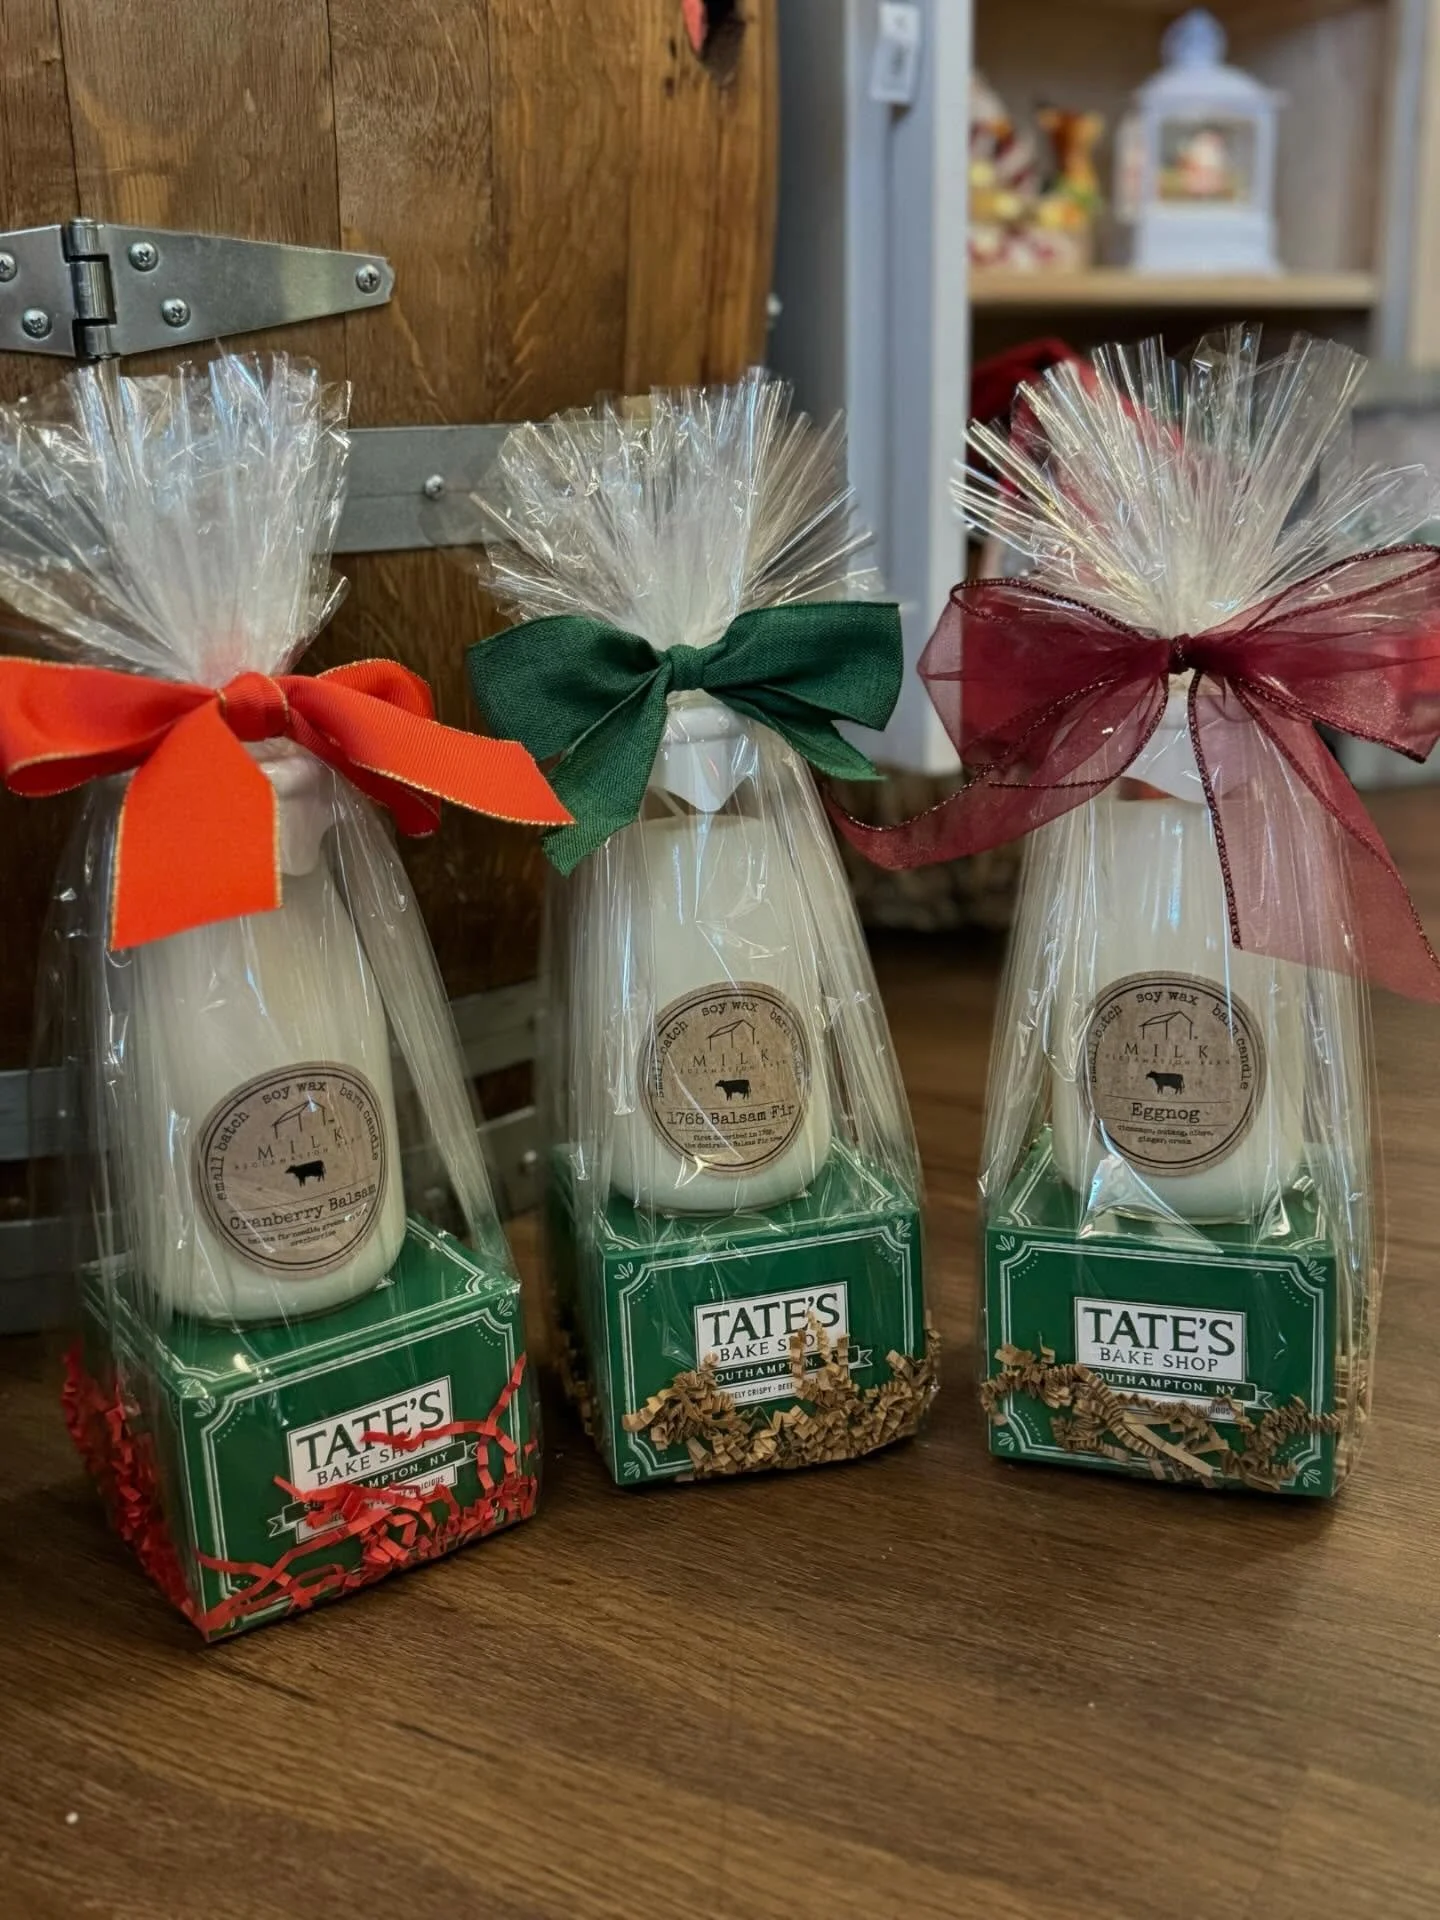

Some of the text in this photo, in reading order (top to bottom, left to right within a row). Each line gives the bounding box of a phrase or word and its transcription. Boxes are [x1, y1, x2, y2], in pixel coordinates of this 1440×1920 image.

[702, 1002, 727, 1017] soy
[731, 1001, 759, 1013] wax
[1124, 1042, 1209, 1059] MILK
[1136, 991, 1164, 1004] soy
[1168, 991, 1200, 1007] wax
[1212, 1003, 1239, 1037] barn
[1236, 1038, 1253, 1090] candle
[692, 1047, 769, 1067] MILK
[667, 1103, 796, 1125] 1768 Balsam Fir
[1131, 1102, 1200, 1124] Eggnog
[211, 1080, 379, 1200] small batch soy wax barn candle
[257, 1127, 342, 1161] MILK
[229, 1203, 324, 1230] Cranberry
[329, 1183, 376, 1208] Balsam
[702, 1292, 840, 1347] TATE'S
[1083, 1306, 1236, 1357] TATE'S
[720, 1342, 770, 1361] BAKE
[1100, 1347, 1218, 1373] BAKE SHOP
[748, 1386, 772, 1397] CRISPY
[1216, 1384, 1237, 1396] NY
[295, 1389, 445, 1473] TATE'S
[317, 1455, 371, 1486] BAKE
[430, 1451, 448, 1466] NY
